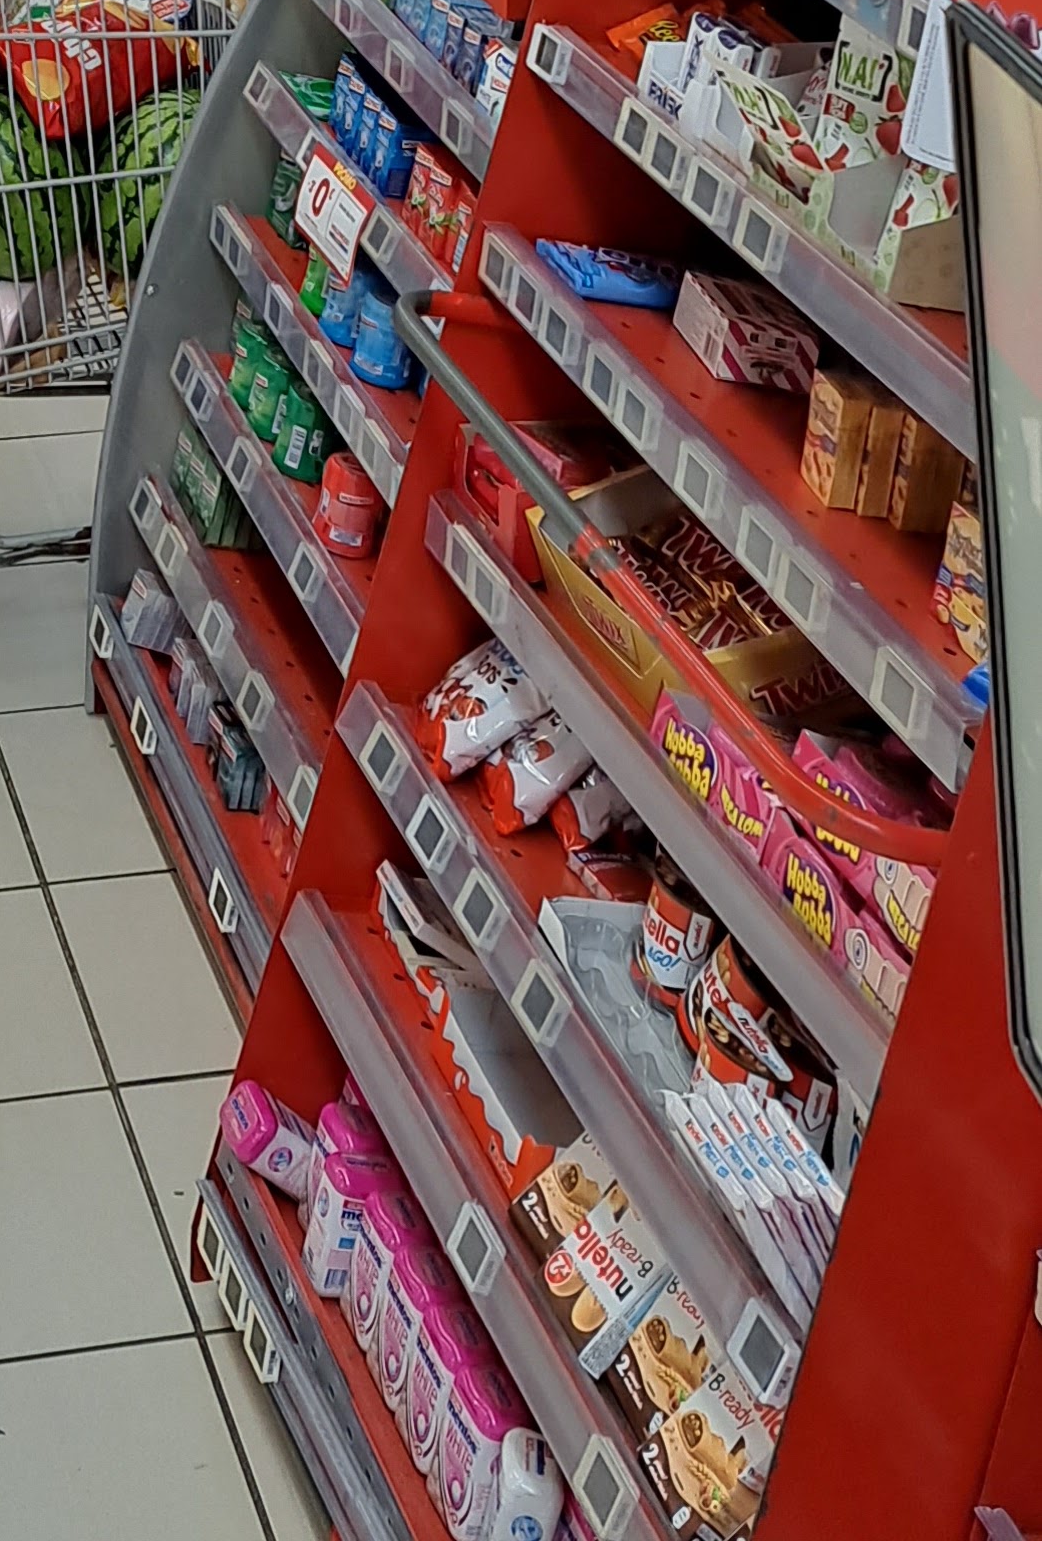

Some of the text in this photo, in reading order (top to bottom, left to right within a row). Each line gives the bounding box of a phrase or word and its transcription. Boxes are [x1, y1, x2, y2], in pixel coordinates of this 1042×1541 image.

[332, 161, 358, 191] PROMO
[665, 718, 706, 763] Hubba
[787, 852, 827, 907] Hubba
[358, 1218, 383, 1270] mentos
[573, 1215, 635, 1303] nutella
[605, 1227, 655, 1280] B-ready
[386, 1279, 413, 1331] mentos
[416, 1334, 445, 1390] mentos
[446, 1400, 479, 1456] mentos
[708, 1374, 757, 1431] B-ready
